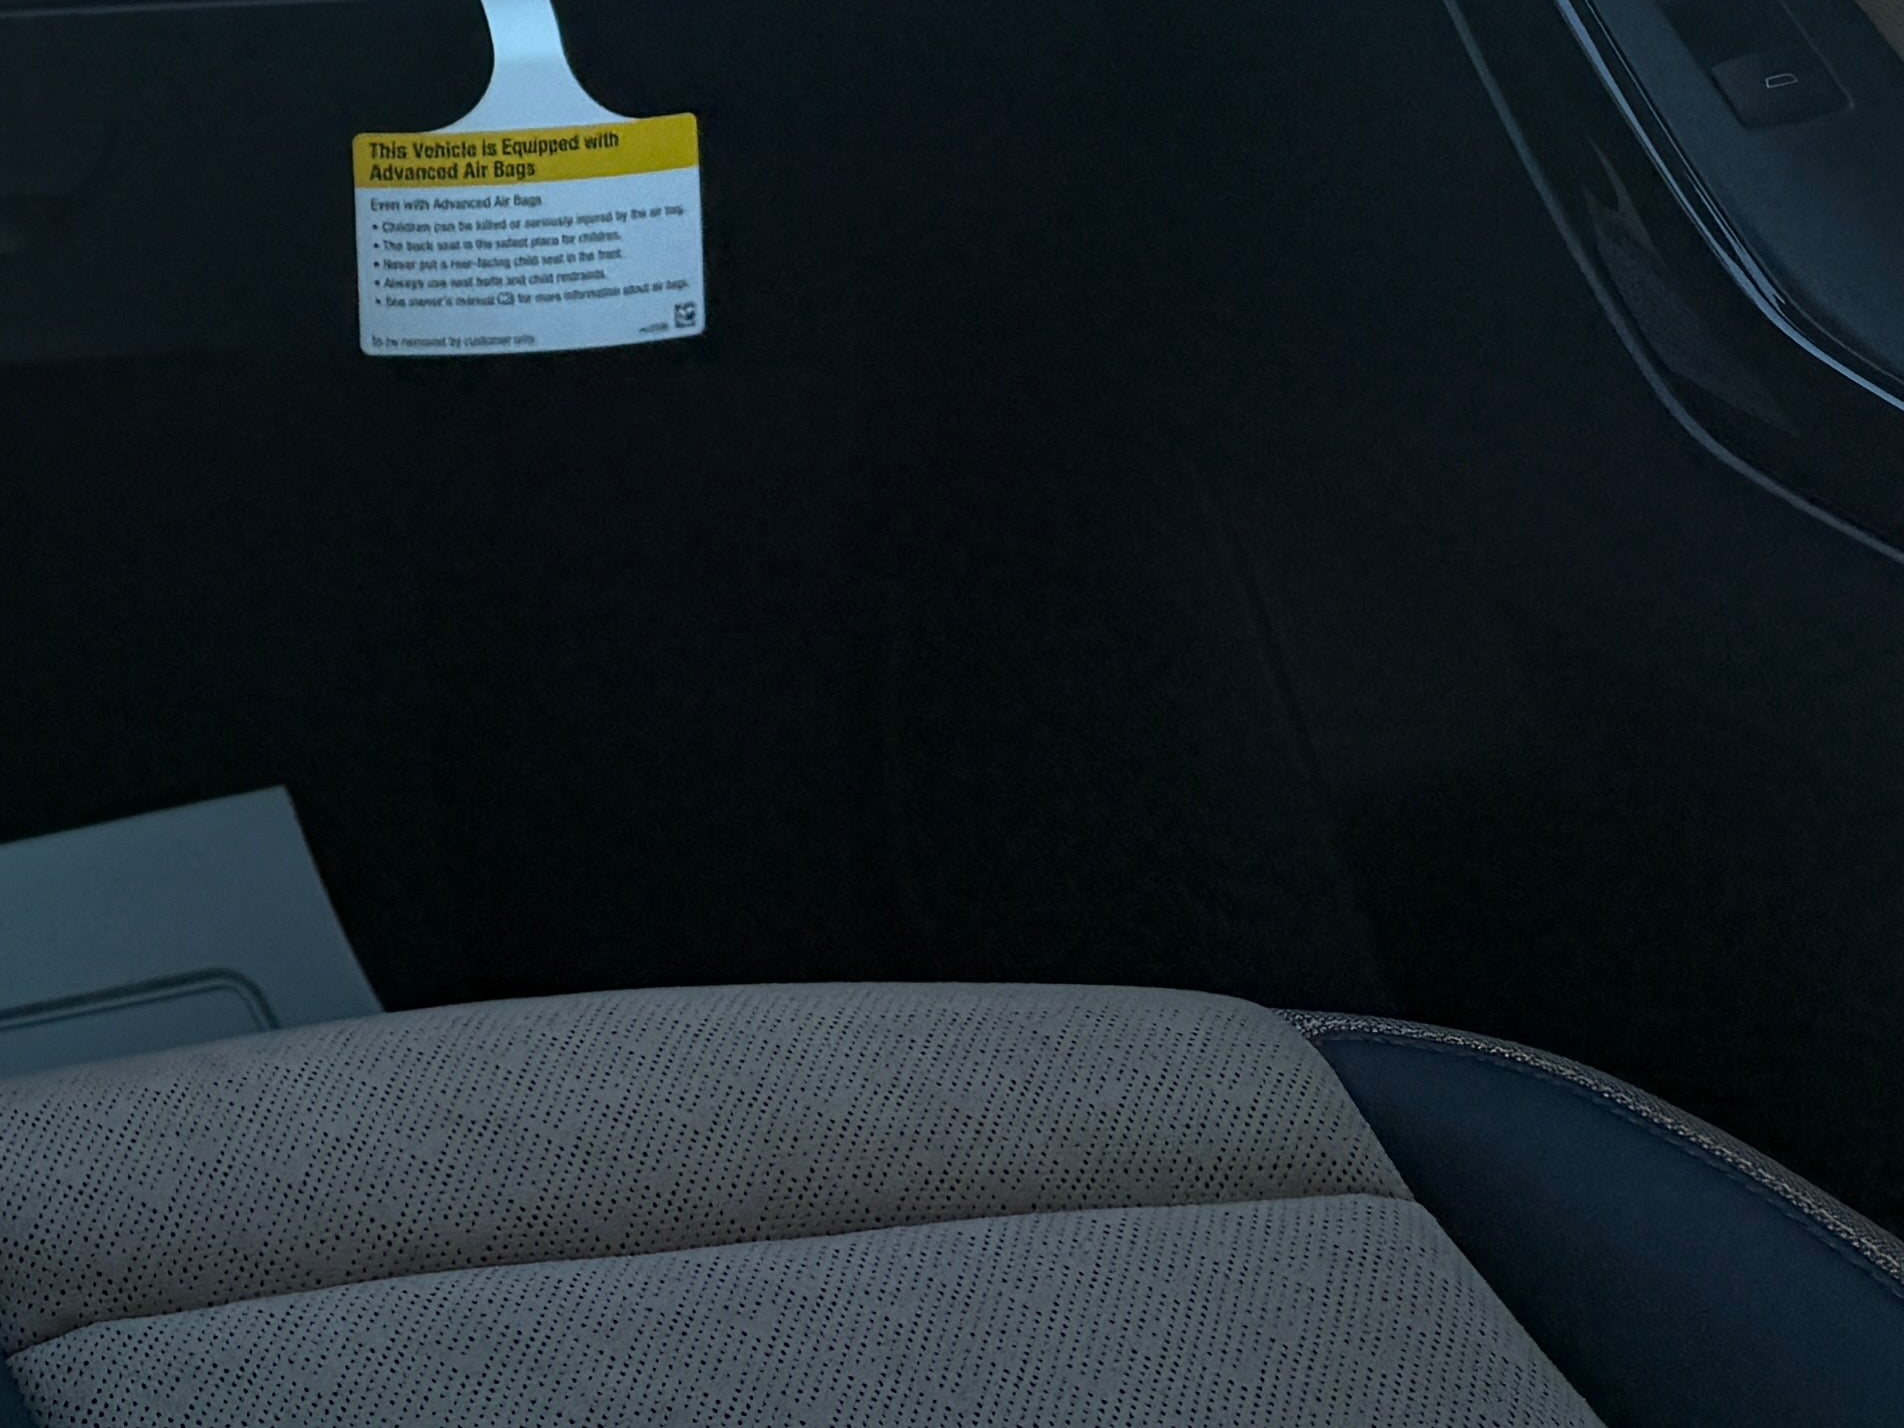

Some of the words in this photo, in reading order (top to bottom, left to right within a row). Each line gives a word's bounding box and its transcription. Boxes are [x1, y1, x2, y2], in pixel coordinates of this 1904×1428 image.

[369, 142, 407, 159] This
[412, 141, 477, 159] Vehicle
[482, 139, 497, 157] is
[501, 135, 579, 158] Equipped
[584, 131, 619, 149] with
[370, 162, 458, 181] Advanced
[463, 161, 488, 179] Air
[494, 160, 535, 180] Bags
[370, 197, 401, 211] Even
[403, 198, 430, 211] with
[433, 196, 491, 211] Advanced
[494, 195, 511, 209] Air
[382, 221, 432, 233] Children
[434, 223, 455, 233] can
[458, 220, 473, 232] be
[476, 219, 507, 231] killed
[525, 215, 574, 229] seriously
[616, 209, 628, 223] by
[630, 208, 647, 219] the
[383, 239, 403, 251] The
[475, 238, 493, 249] the
[419, 259, 438, 271] put
[513, 255, 539, 267] child
[578, 251, 594, 262] the
[384, 277, 424, 290] Always
[529, 273, 554, 285] child
